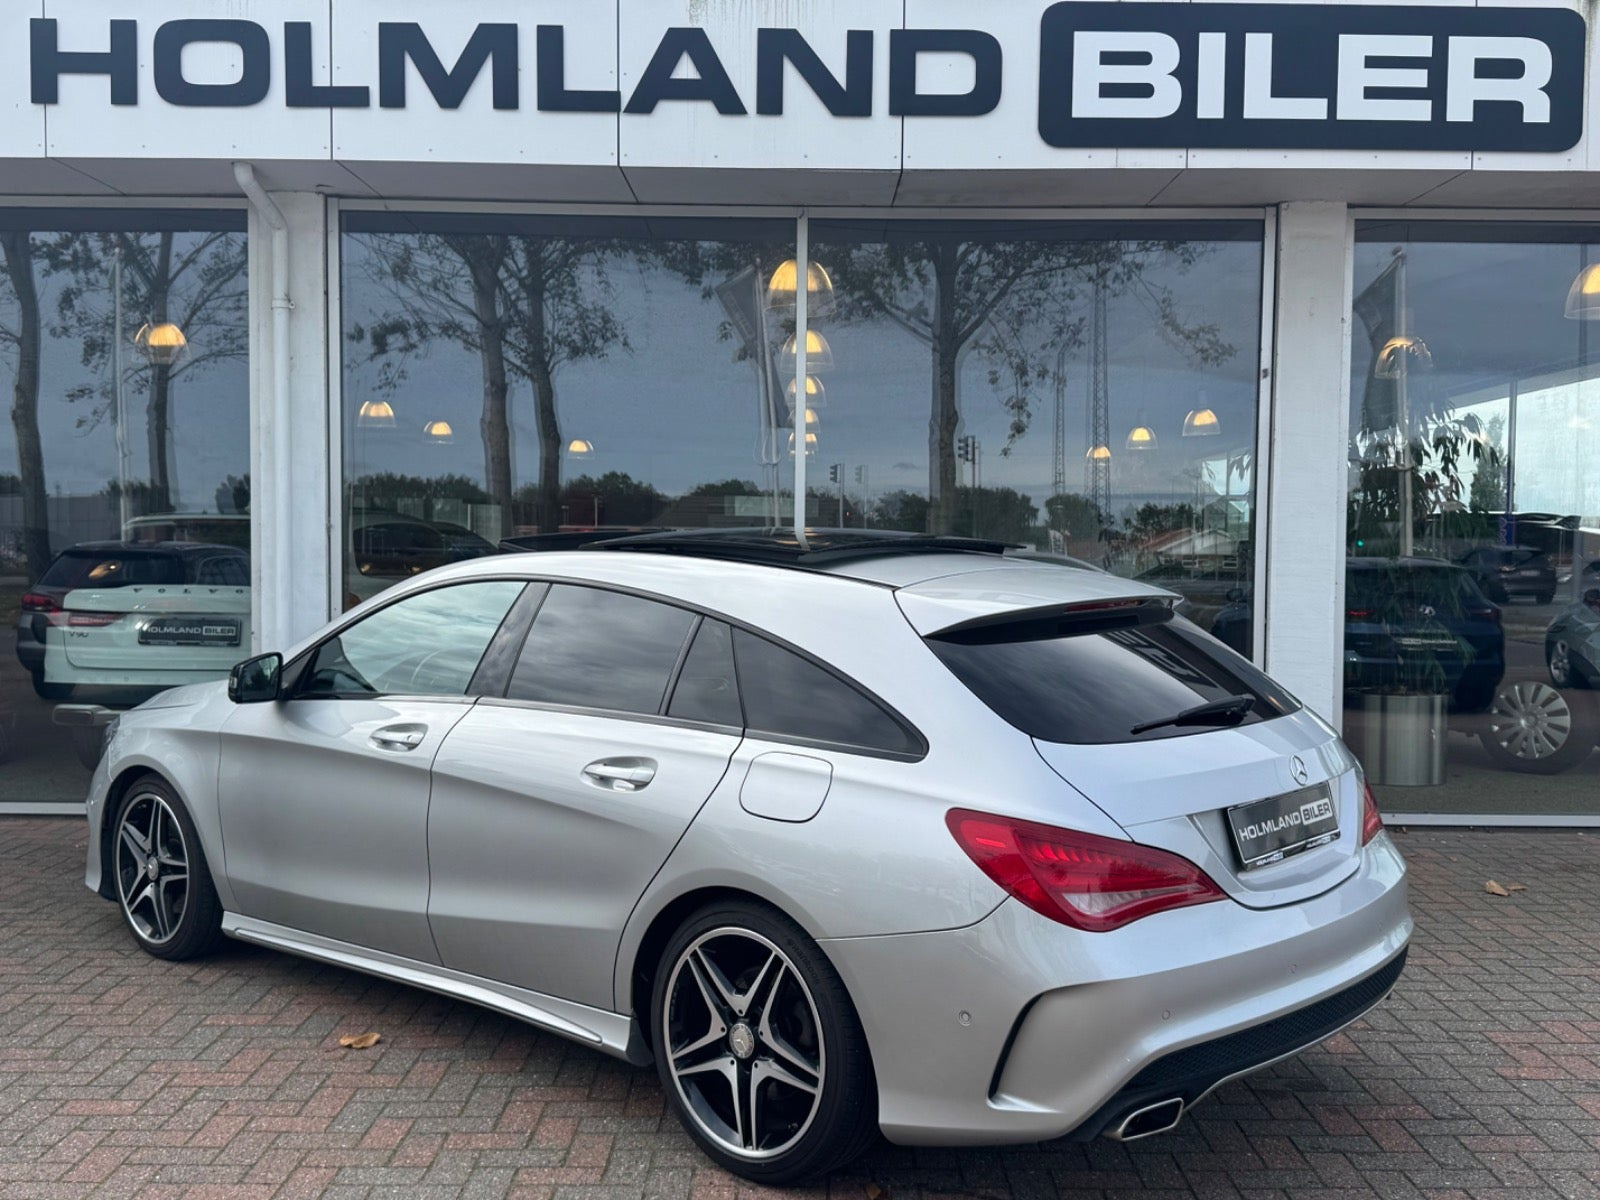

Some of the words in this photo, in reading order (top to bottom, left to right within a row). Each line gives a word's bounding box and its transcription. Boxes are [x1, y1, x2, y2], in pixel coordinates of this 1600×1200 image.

[30, 18, 1002, 116] HOLMLAND
[1071, 31, 1553, 123] BILER
[1239, 812, 1301, 842] HOLMLAND
[1302, 802, 1331, 821] BILER
